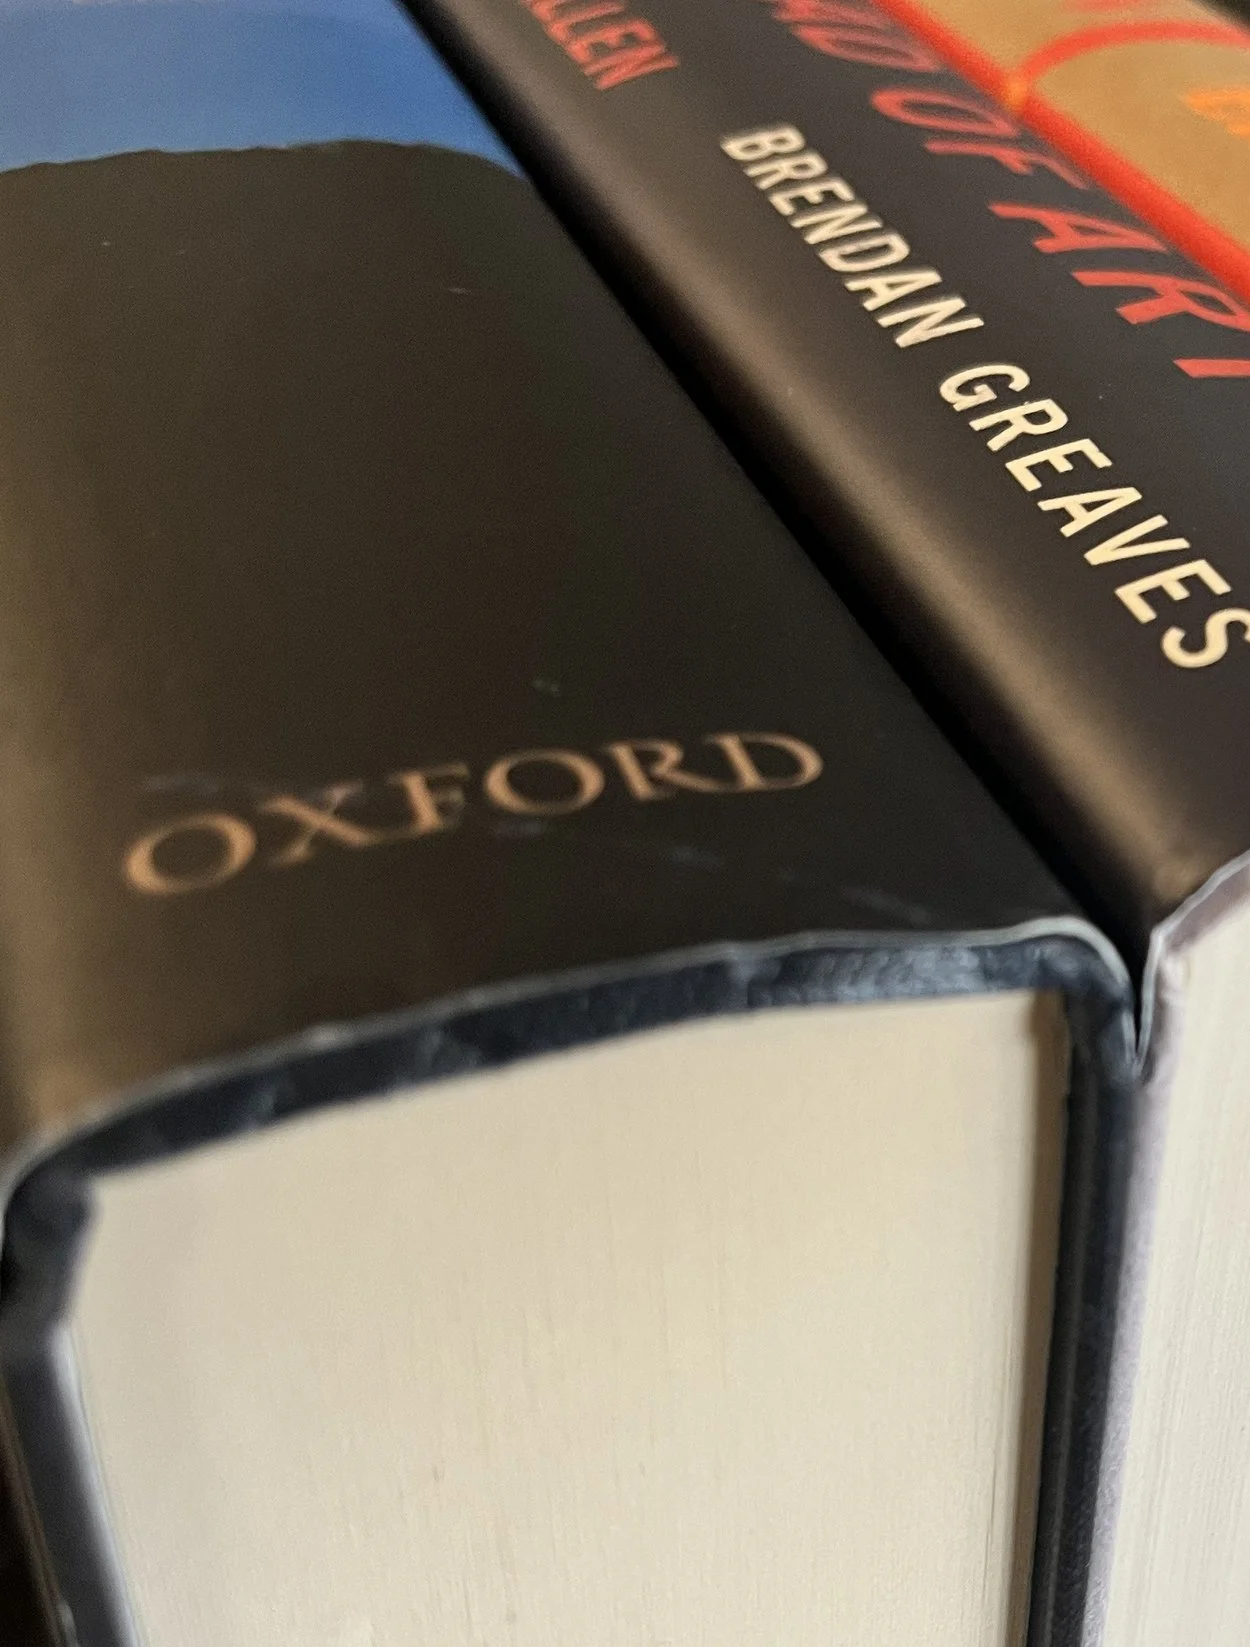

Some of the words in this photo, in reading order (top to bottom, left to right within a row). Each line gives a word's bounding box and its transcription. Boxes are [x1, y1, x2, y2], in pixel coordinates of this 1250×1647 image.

[870, 86, 1090, 190] OF
[719, 123, 985, 348] BRENDAN
[123, 732, 824, 895] OXFORD
